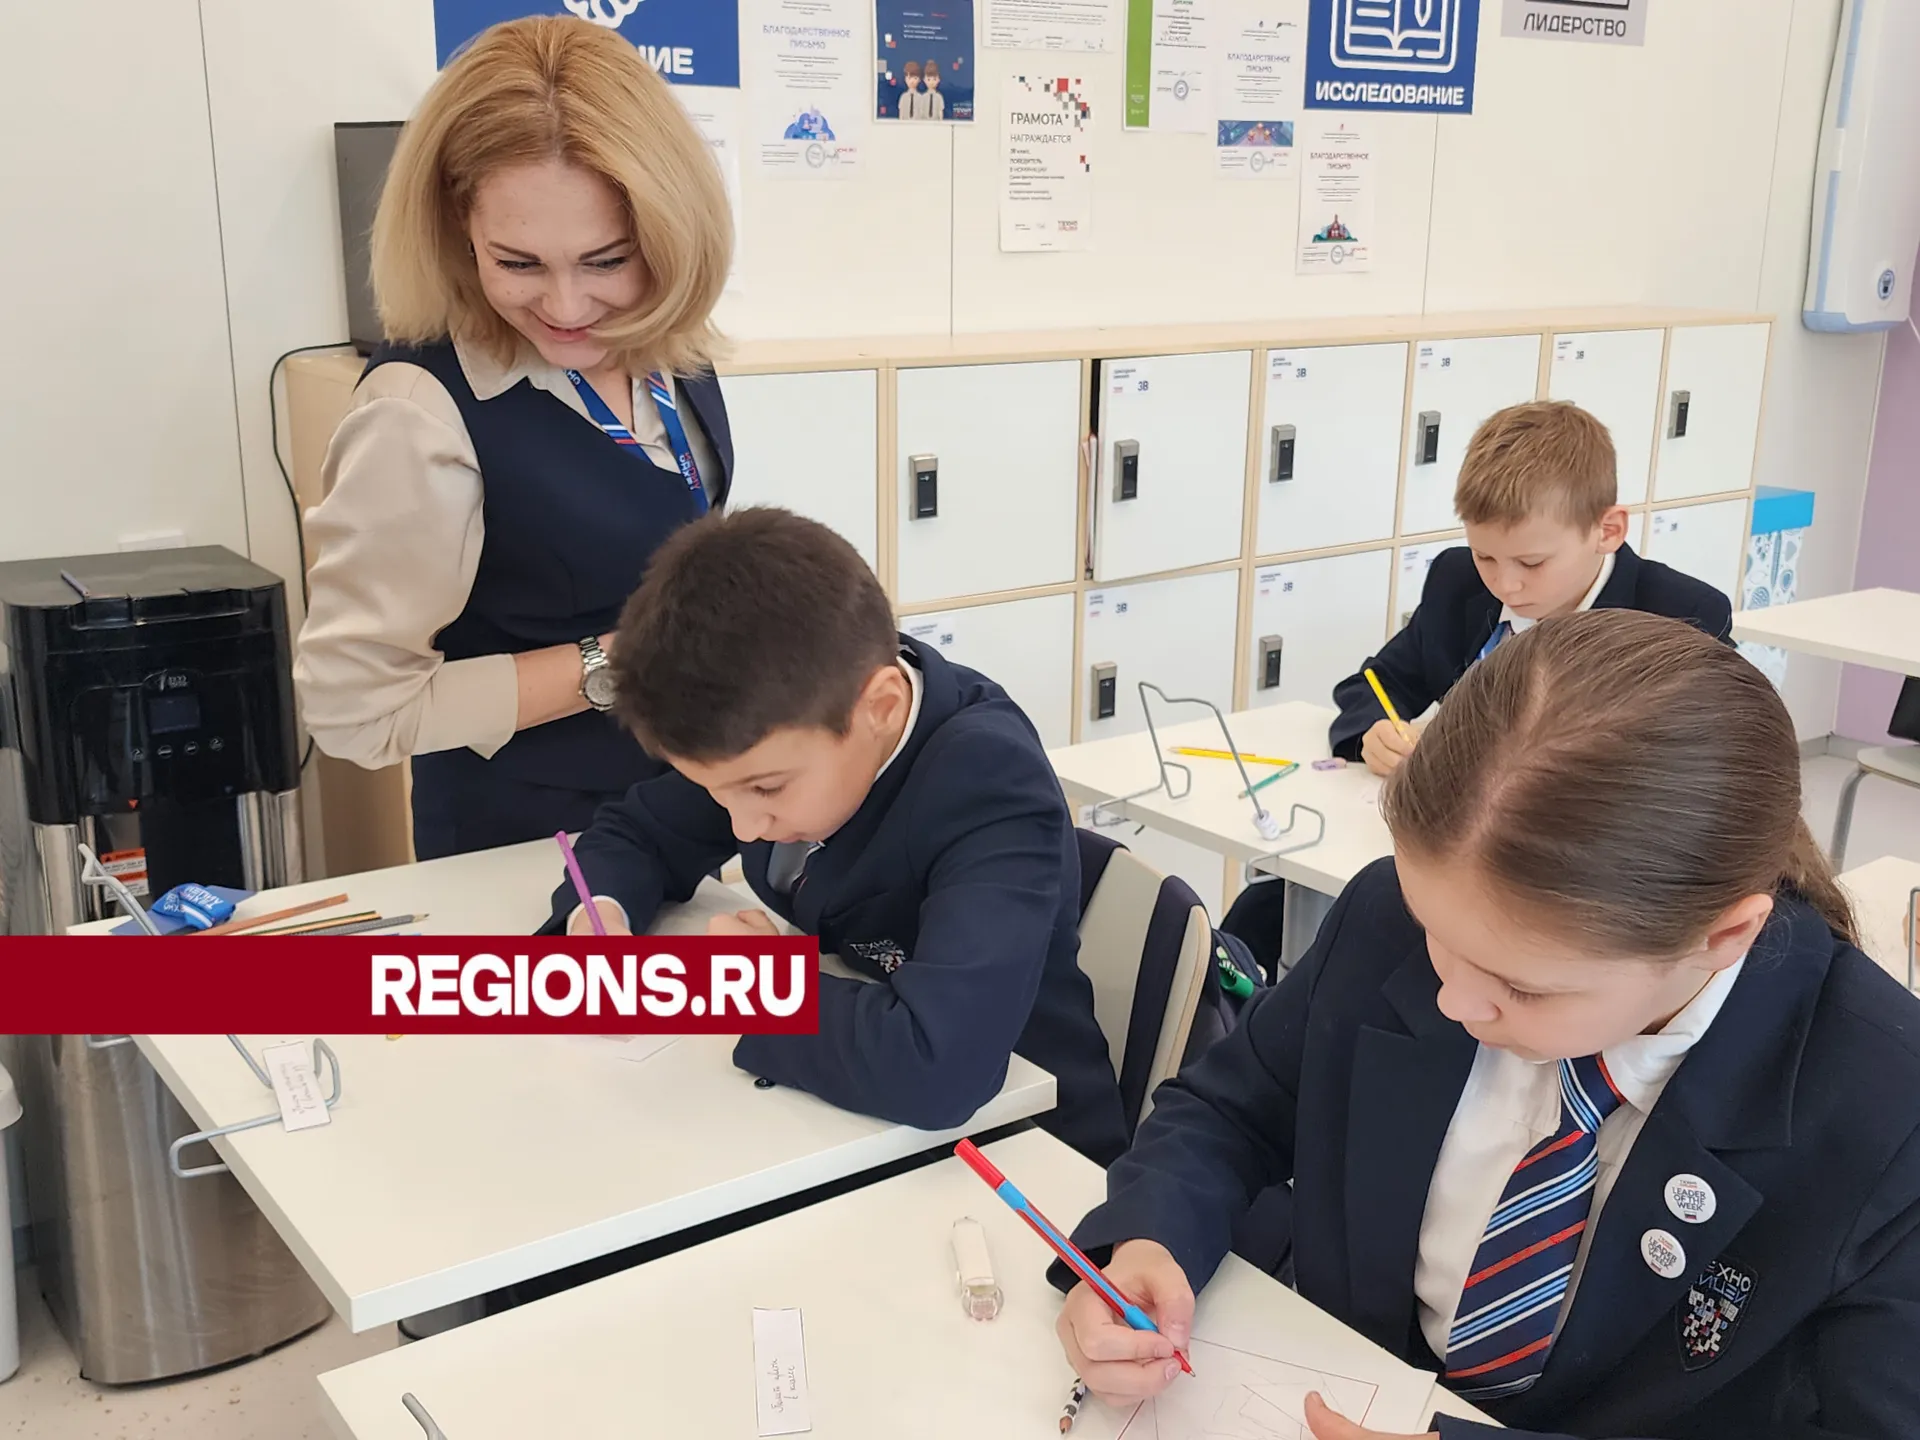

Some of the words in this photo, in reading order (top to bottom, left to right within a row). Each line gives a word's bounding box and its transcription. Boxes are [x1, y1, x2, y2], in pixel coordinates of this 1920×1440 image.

[762, 24, 851, 38] БЛАГОДАРСТВЕННОЕ
[1523, 13, 1627, 37] ЛИДЕРСТВО
[789, 39, 826, 49] ПИСЬМО
[1315, 80, 1465, 106] ИССЛЕДОВАНИЕ
[1010, 112, 1063, 125] ГРАМОТА
[1010, 133, 1071, 143] НАГРАЖДАЕТСЯ
[1672, 1186, 1706, 1199] LEADER
[1673, 1194, 1687, 1202] OF
[1688, 1196, 1706, 1206] THE
[1677, 1200, 1704, 1212] WEEK
[1648, 1236, 1677, 1263] LEADER
